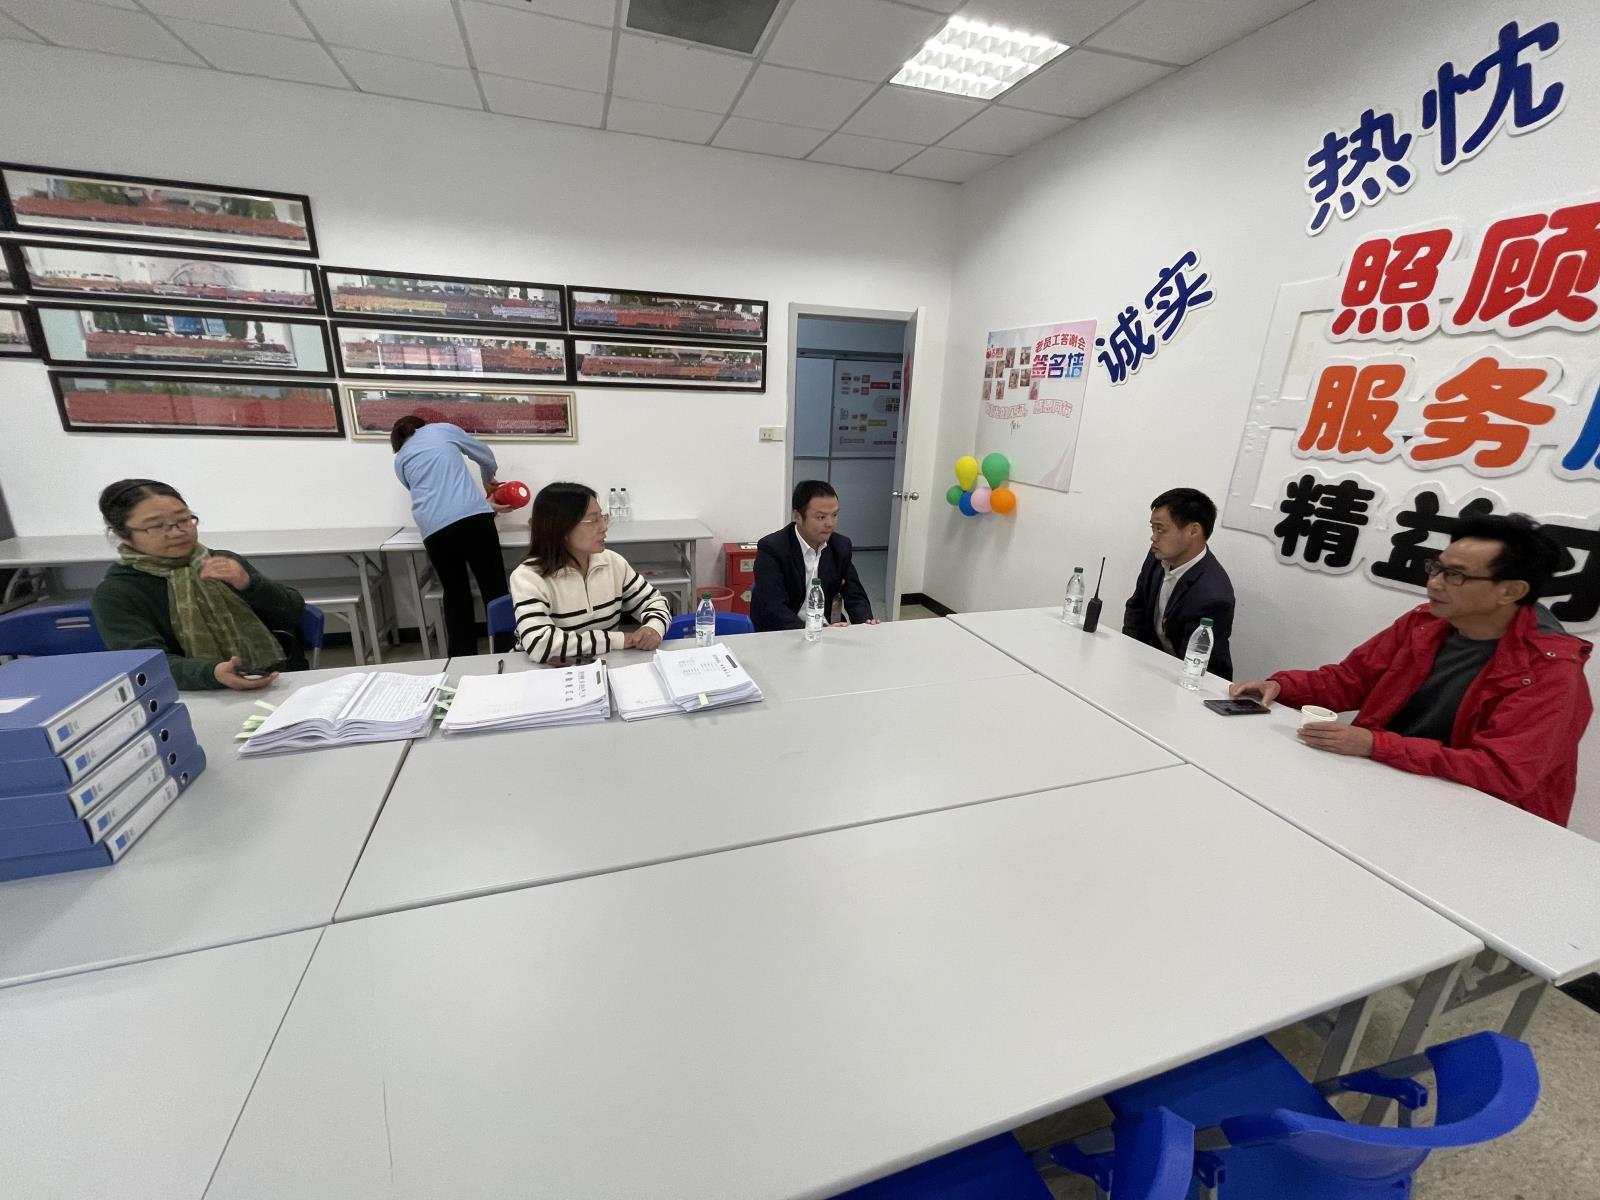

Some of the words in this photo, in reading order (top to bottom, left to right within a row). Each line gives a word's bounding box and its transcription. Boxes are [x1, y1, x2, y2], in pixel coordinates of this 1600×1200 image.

[1308, 21, 1564, 231] 热忱
[1096, 251, 1213, 382] 诚实
[1331, 201, 1600, 335] 照顾
[1031, 352, 1085, 379] 签名墙
[1035, 333, 1087, 353] 老员工答谢会
[1298, 356, 1600, 470] 服务
